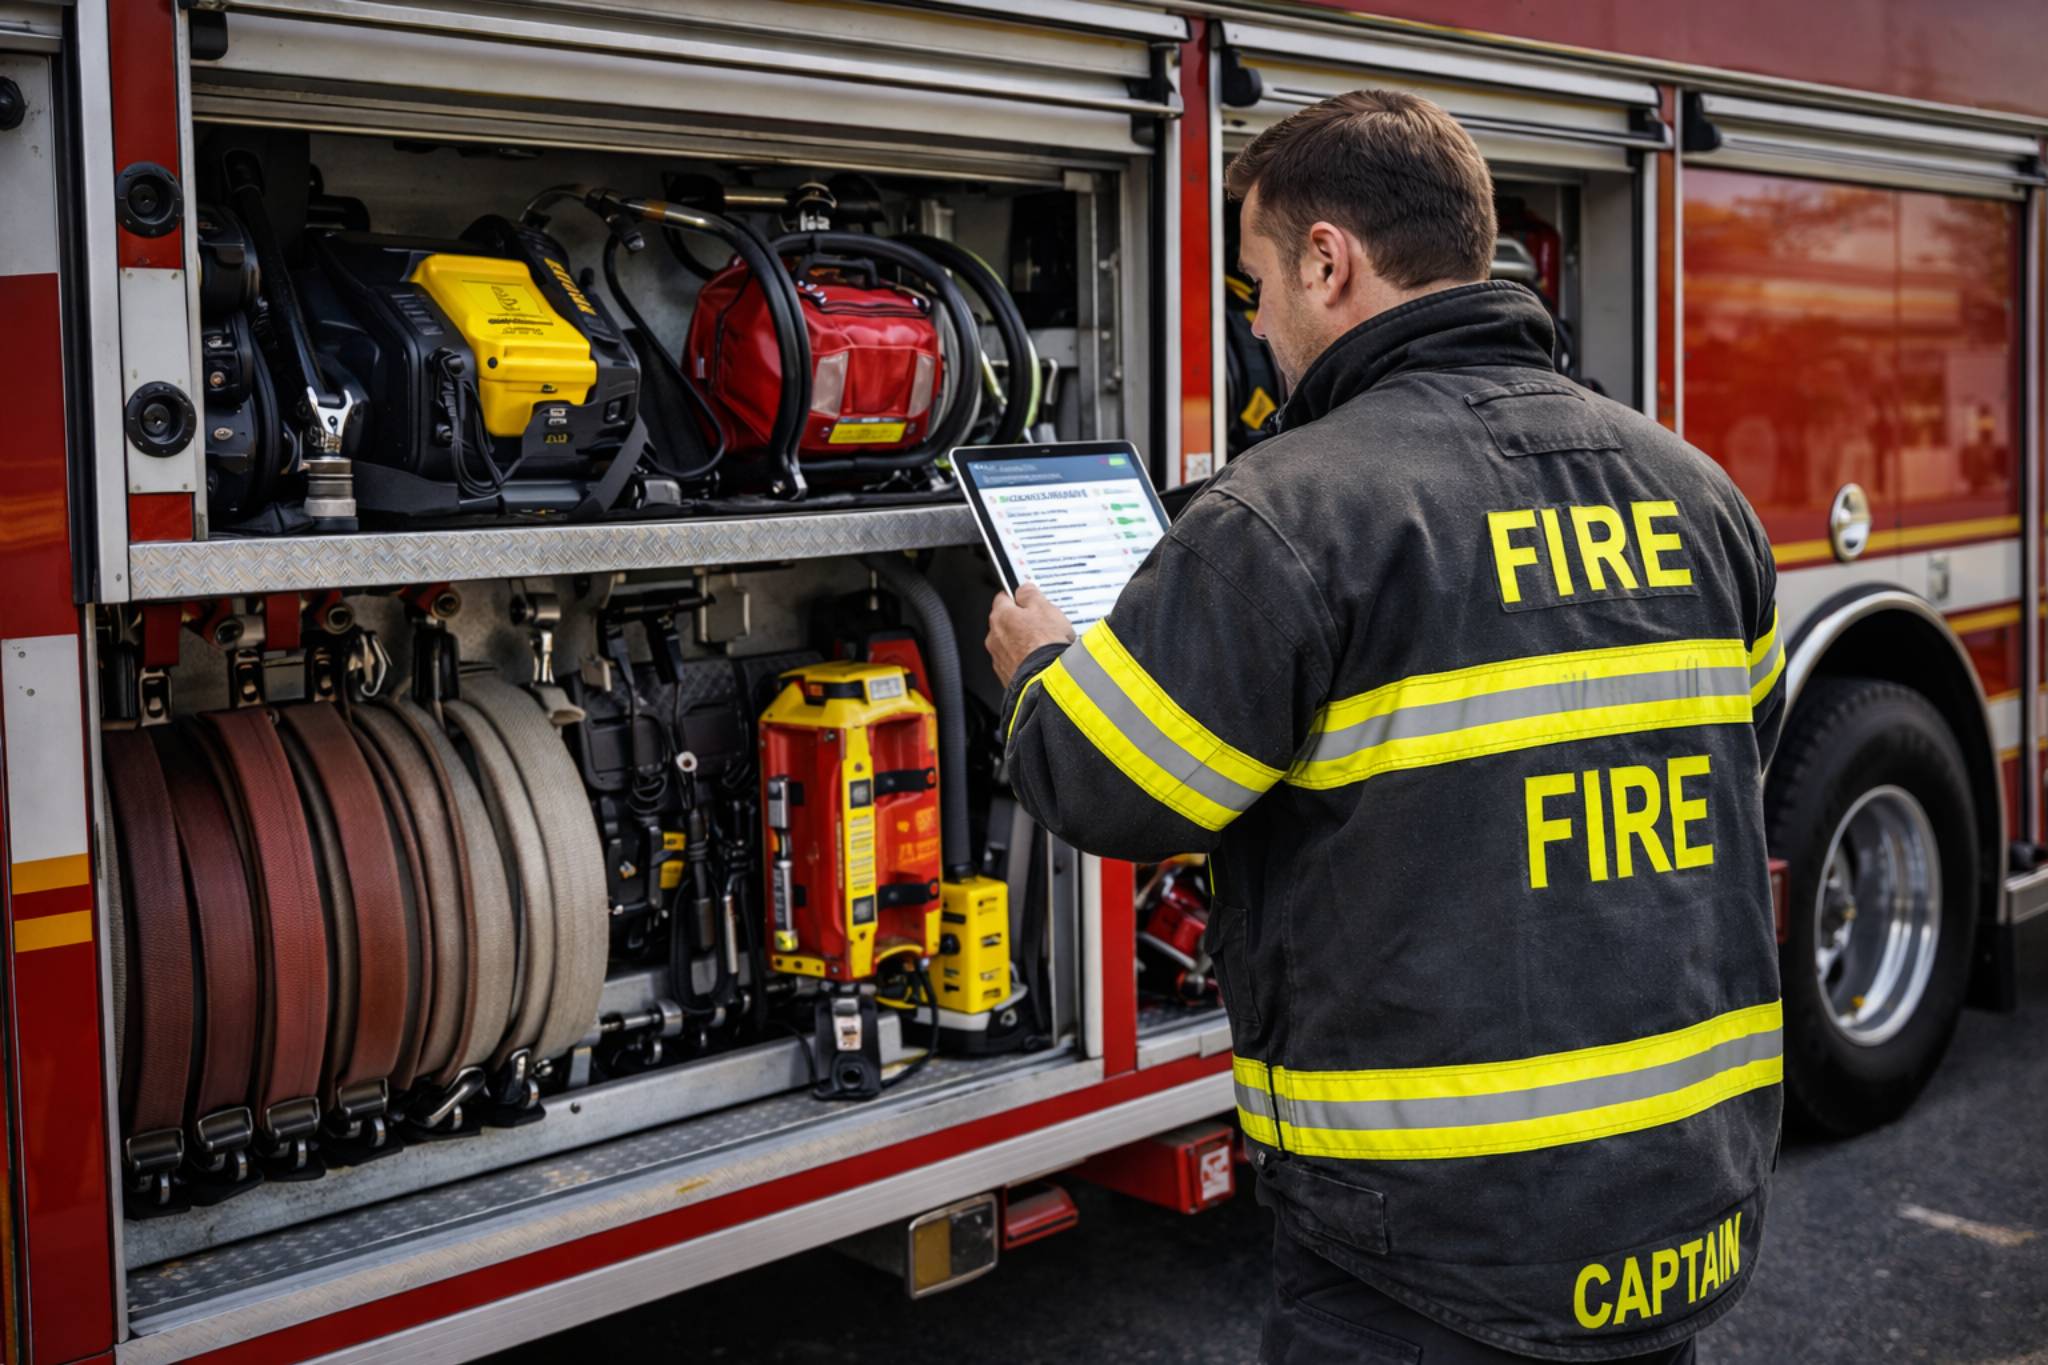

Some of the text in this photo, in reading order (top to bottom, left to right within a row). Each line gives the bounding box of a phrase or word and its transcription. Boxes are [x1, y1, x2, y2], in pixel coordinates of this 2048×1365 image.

[1487, 501, 1694, 603] FIRE
[1525, 755, 1714, 889] FIRE
[1574, 1212, 1742, 1329] CAPTAIN
